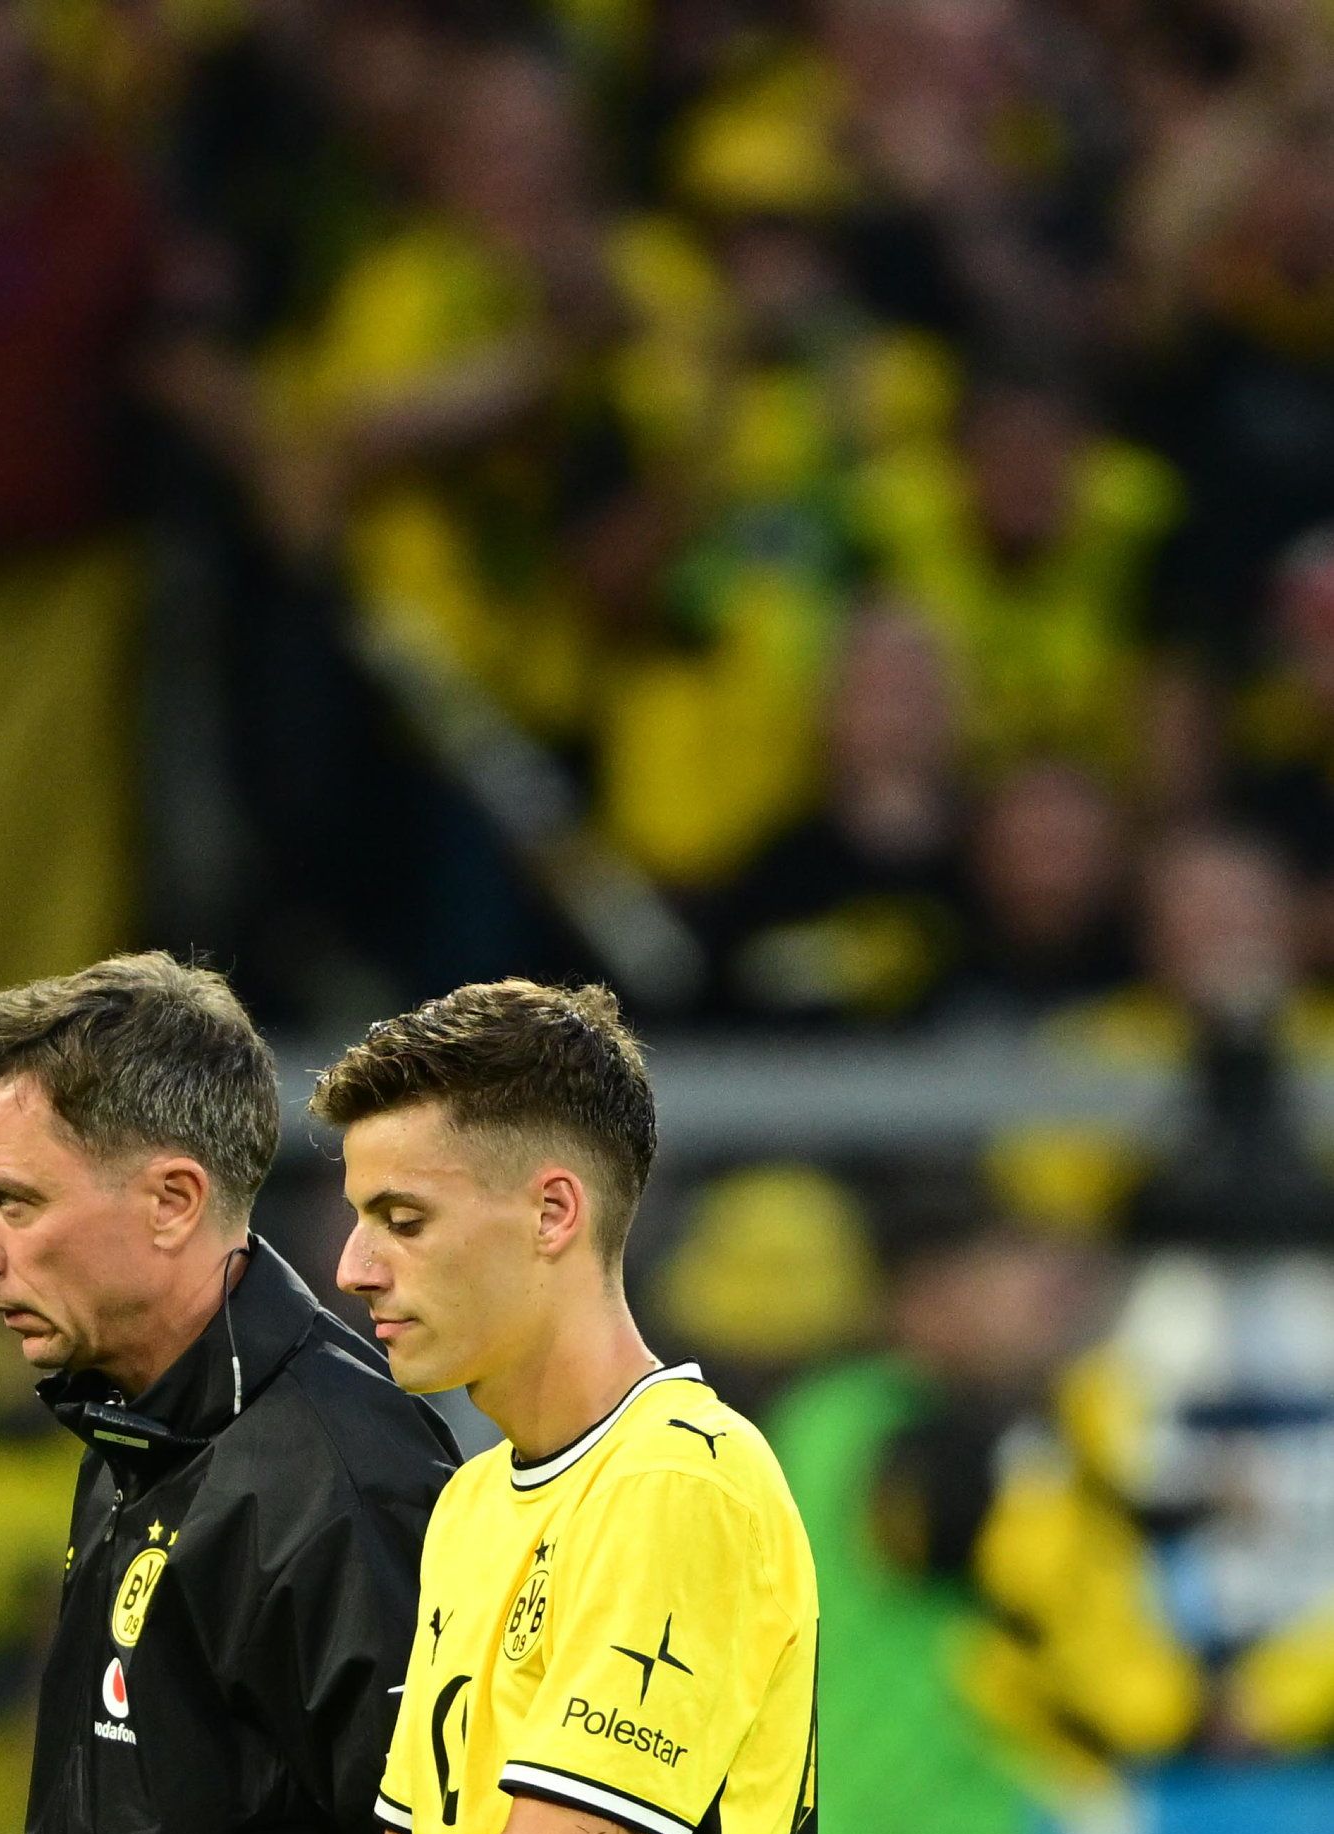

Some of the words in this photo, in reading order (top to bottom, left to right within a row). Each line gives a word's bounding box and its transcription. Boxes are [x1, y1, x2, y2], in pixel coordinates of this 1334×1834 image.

[122, 1559, 163, 1611] BV
[508, 1579, 546, 1633] BVB
[511, 1633, 527, 1653] 09
[561, 1697, 689, 1769] Polestar
